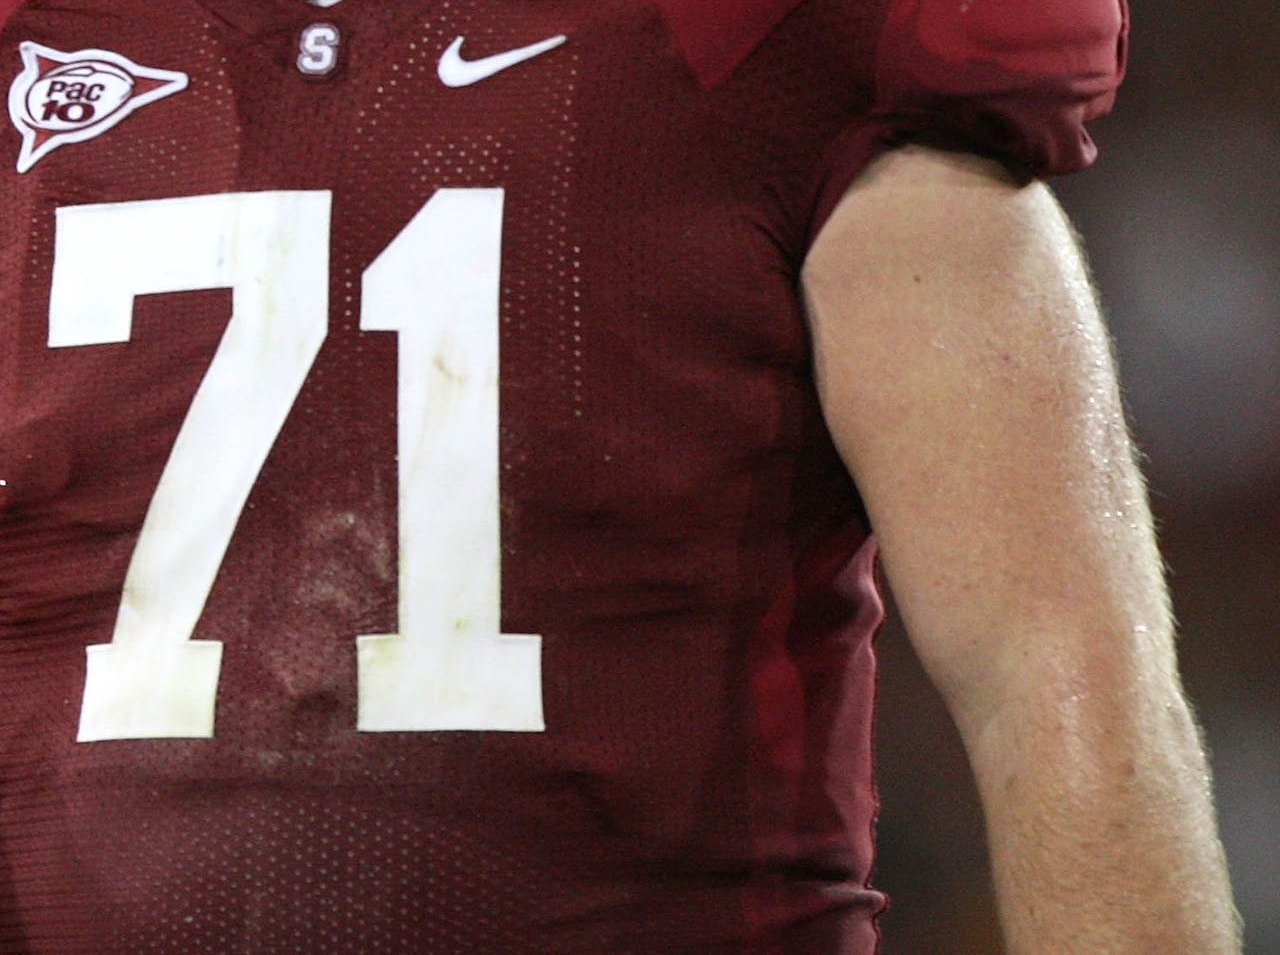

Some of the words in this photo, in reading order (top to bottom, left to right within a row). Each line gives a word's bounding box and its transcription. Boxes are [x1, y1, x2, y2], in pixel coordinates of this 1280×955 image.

[296, 23, 340, 75] S
[41, 100, 95, 123] 10
[47, 188, 545, 742] 71
